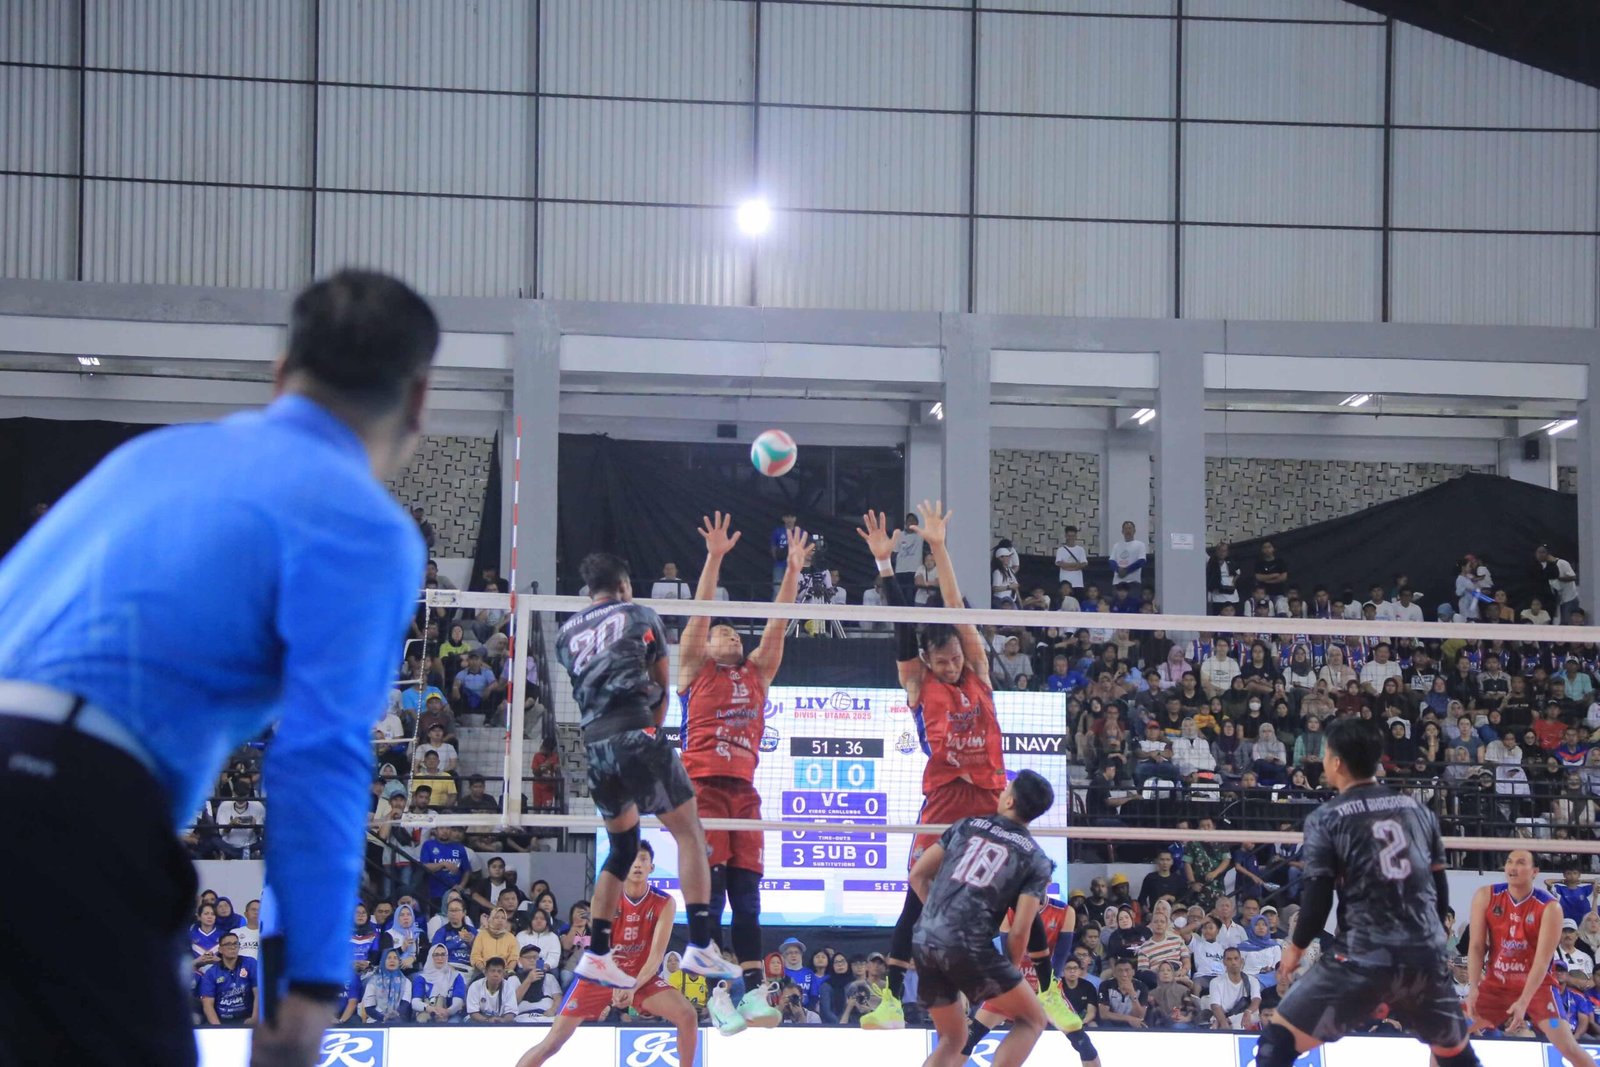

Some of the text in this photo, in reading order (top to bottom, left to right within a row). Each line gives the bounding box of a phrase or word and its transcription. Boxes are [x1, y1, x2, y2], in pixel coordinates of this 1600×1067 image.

[569, 612, 625, 676] 20
[794, 711, 817, 719] DIVISI
[824, 711, 851, 719] UTAMA
[852, 712, 872, 720] 2025
[812, 740, 828, 754] 51
[845, 741, 863, 755] 36
[1015, 737, 1063, 752] NAVY
[805, 763, 823, 785] 0
[847, 764, 866, 787] 0
[792, 796, 806, 813] 0
[821, 792, 849, 807] VC
[865, 798, 879, 815] 0
[792, 848, 805, 865] 3
[812, 845, 857, 860] SUB
[864, 849, 879, 866] 0
[1372, 819, 1412, 880] 2
[951, 836, 1009, 888] 18
[783, 881, 791, 889] 2
[874, 883, 909, 891] SET 3
